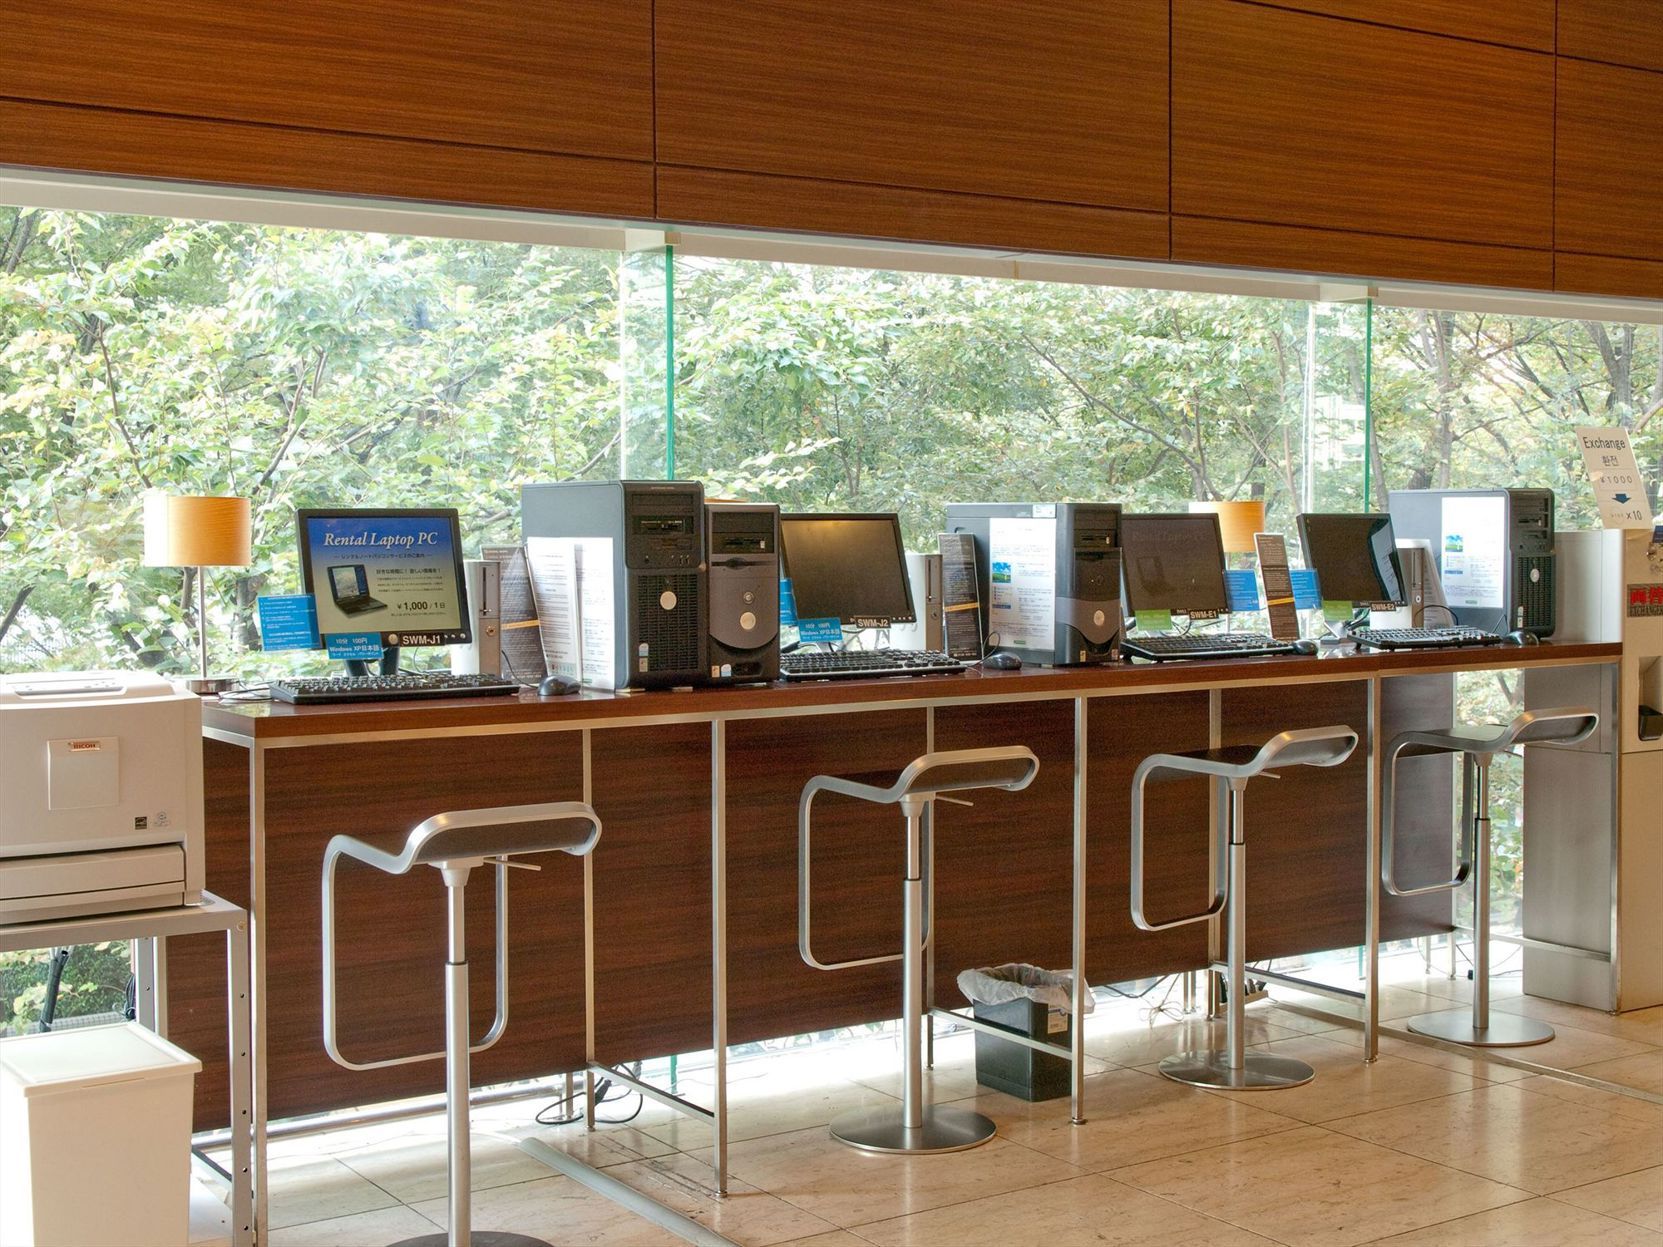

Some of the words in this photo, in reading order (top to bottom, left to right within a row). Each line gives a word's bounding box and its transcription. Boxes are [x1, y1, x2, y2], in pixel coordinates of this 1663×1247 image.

[1582, 437, 1626, 450] Exchange
[323, 531, 368, 546] Rental
[369, 532, 415, 549] Laptop
[417, 531, 438, 545] PC
[1371, 603, 1395, 611] SWM-E2
[1190, 610, 1217, 619] SWM-E1
[857, 618, 888, 627] SWM-J2
[402, 635, 441, 645] SWM-J1
